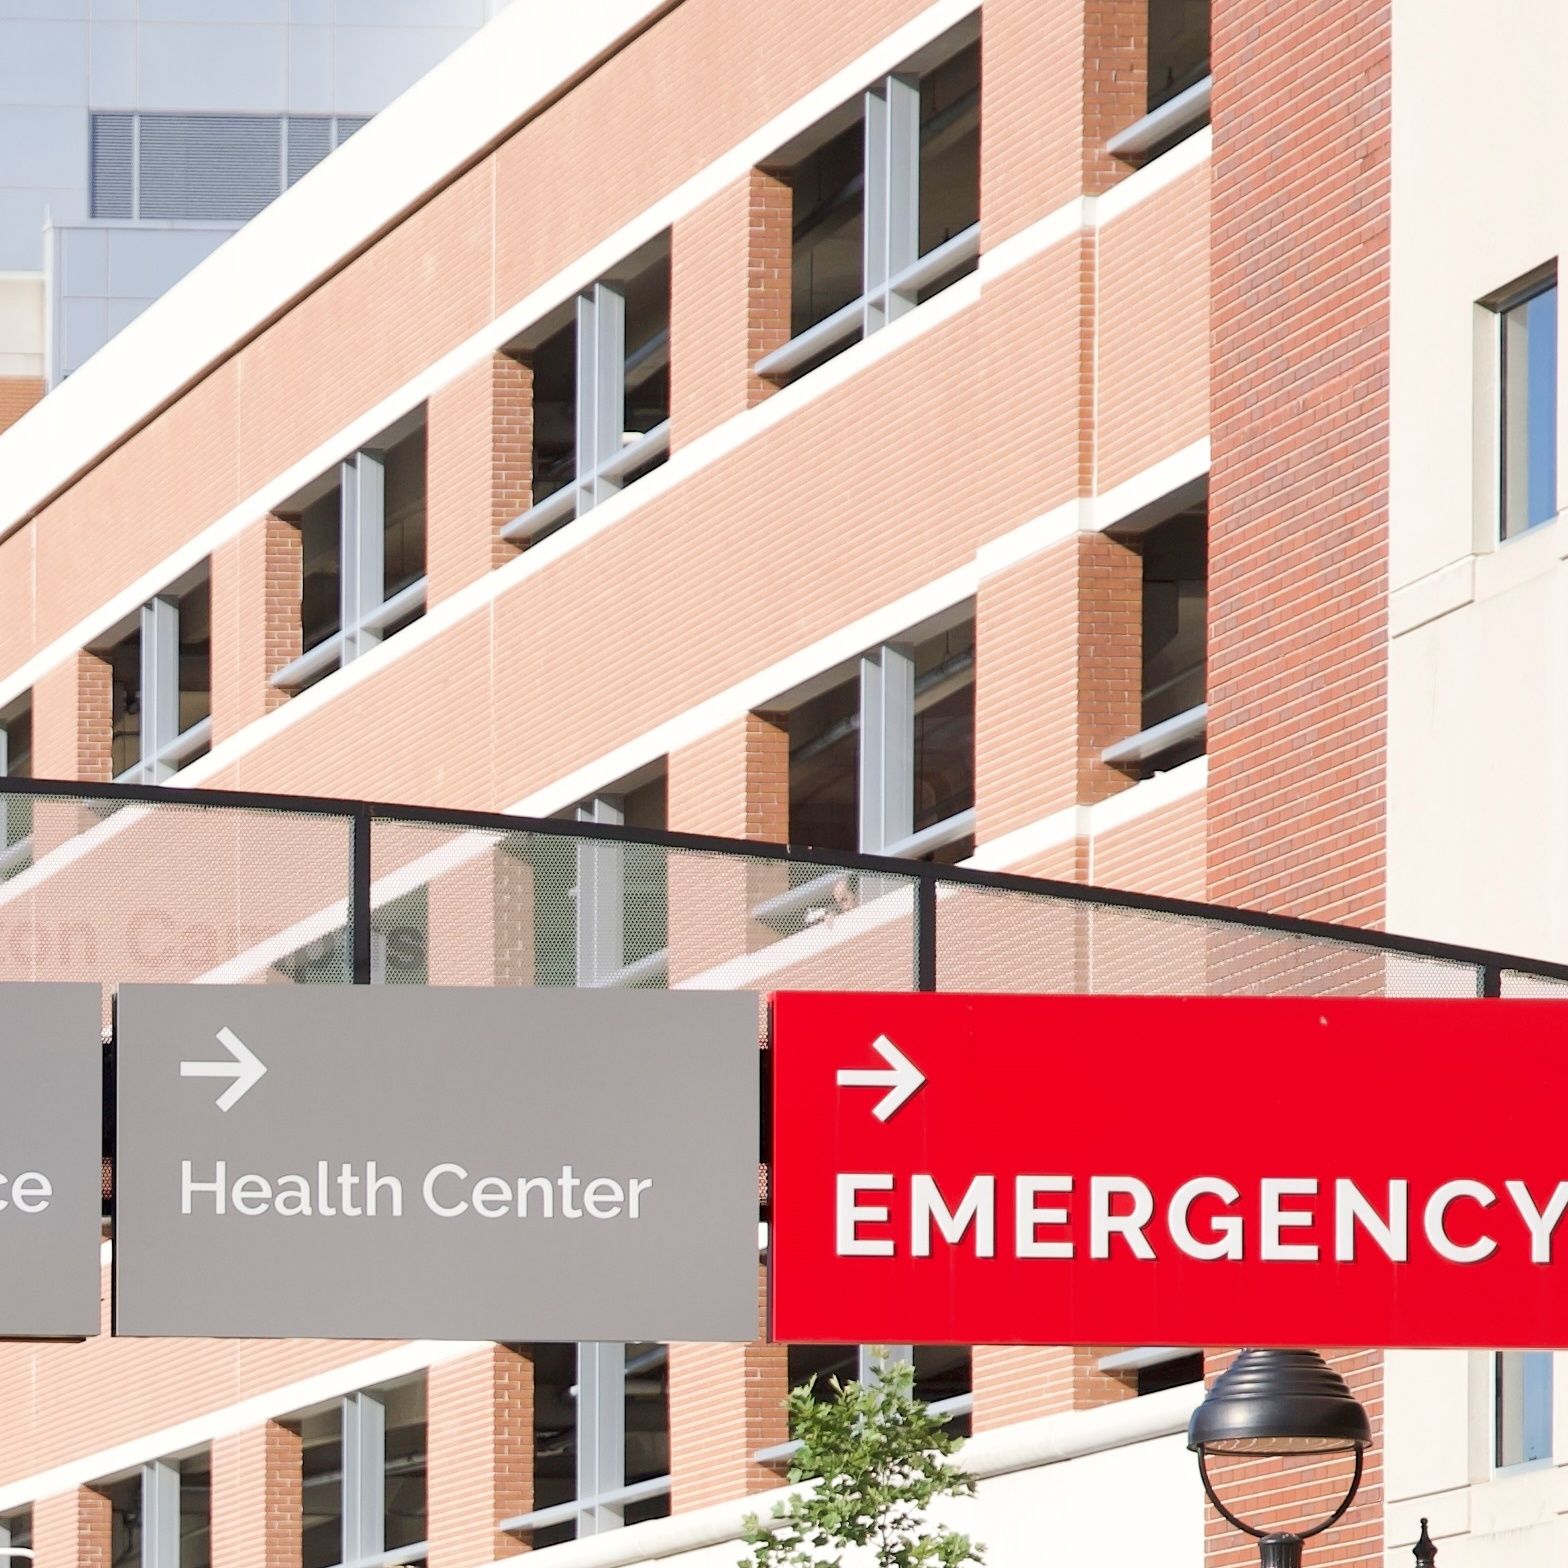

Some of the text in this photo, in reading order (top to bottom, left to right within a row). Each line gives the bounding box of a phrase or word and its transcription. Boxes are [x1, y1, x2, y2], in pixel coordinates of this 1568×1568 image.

[180, 1159, 654, 1220] Health Center
[836, 1172, 1568, 1264] EMERGENCY
